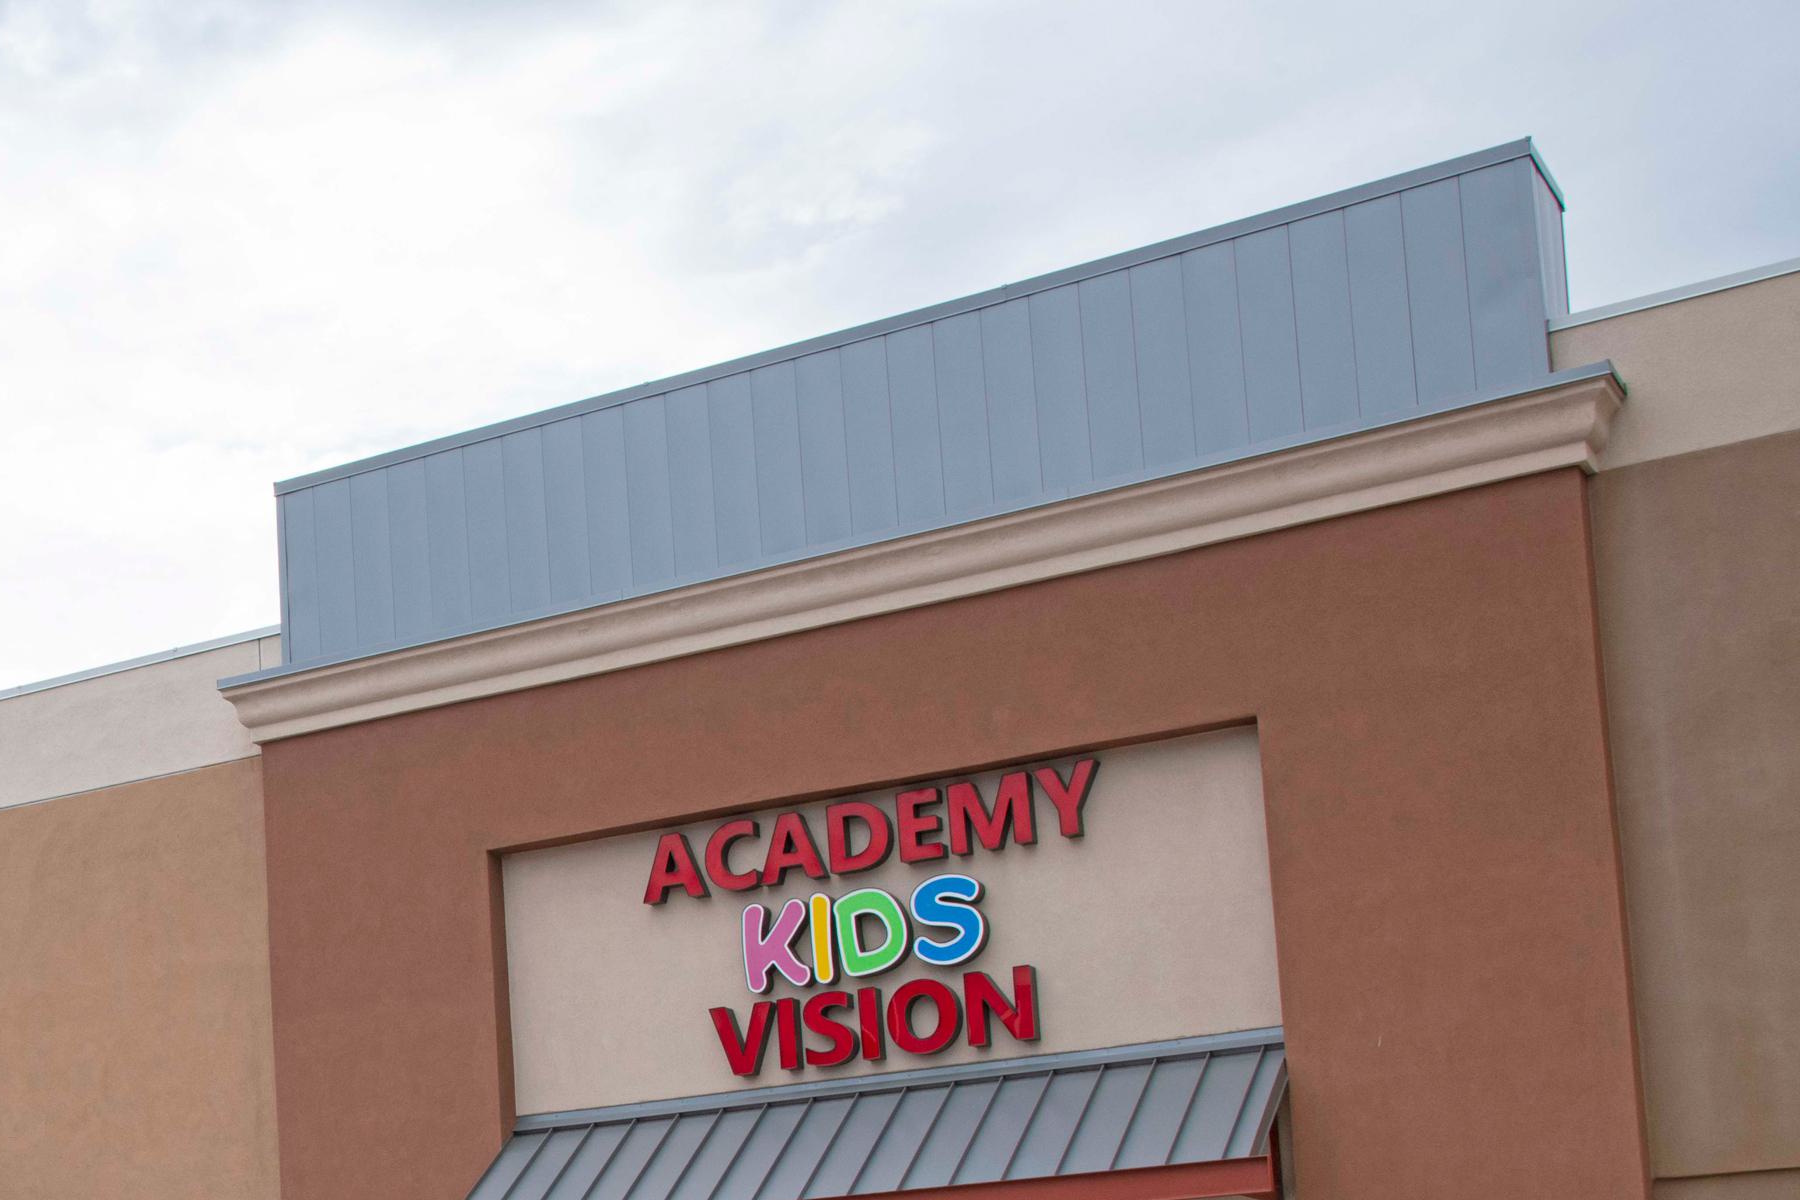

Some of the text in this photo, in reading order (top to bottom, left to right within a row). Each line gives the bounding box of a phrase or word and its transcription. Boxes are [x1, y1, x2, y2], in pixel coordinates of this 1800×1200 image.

[644, 759, 1099, 906] ACADEMY
[741, 873, 990, 994] KIDS
[709, 965, 1040, 1077] VISION
